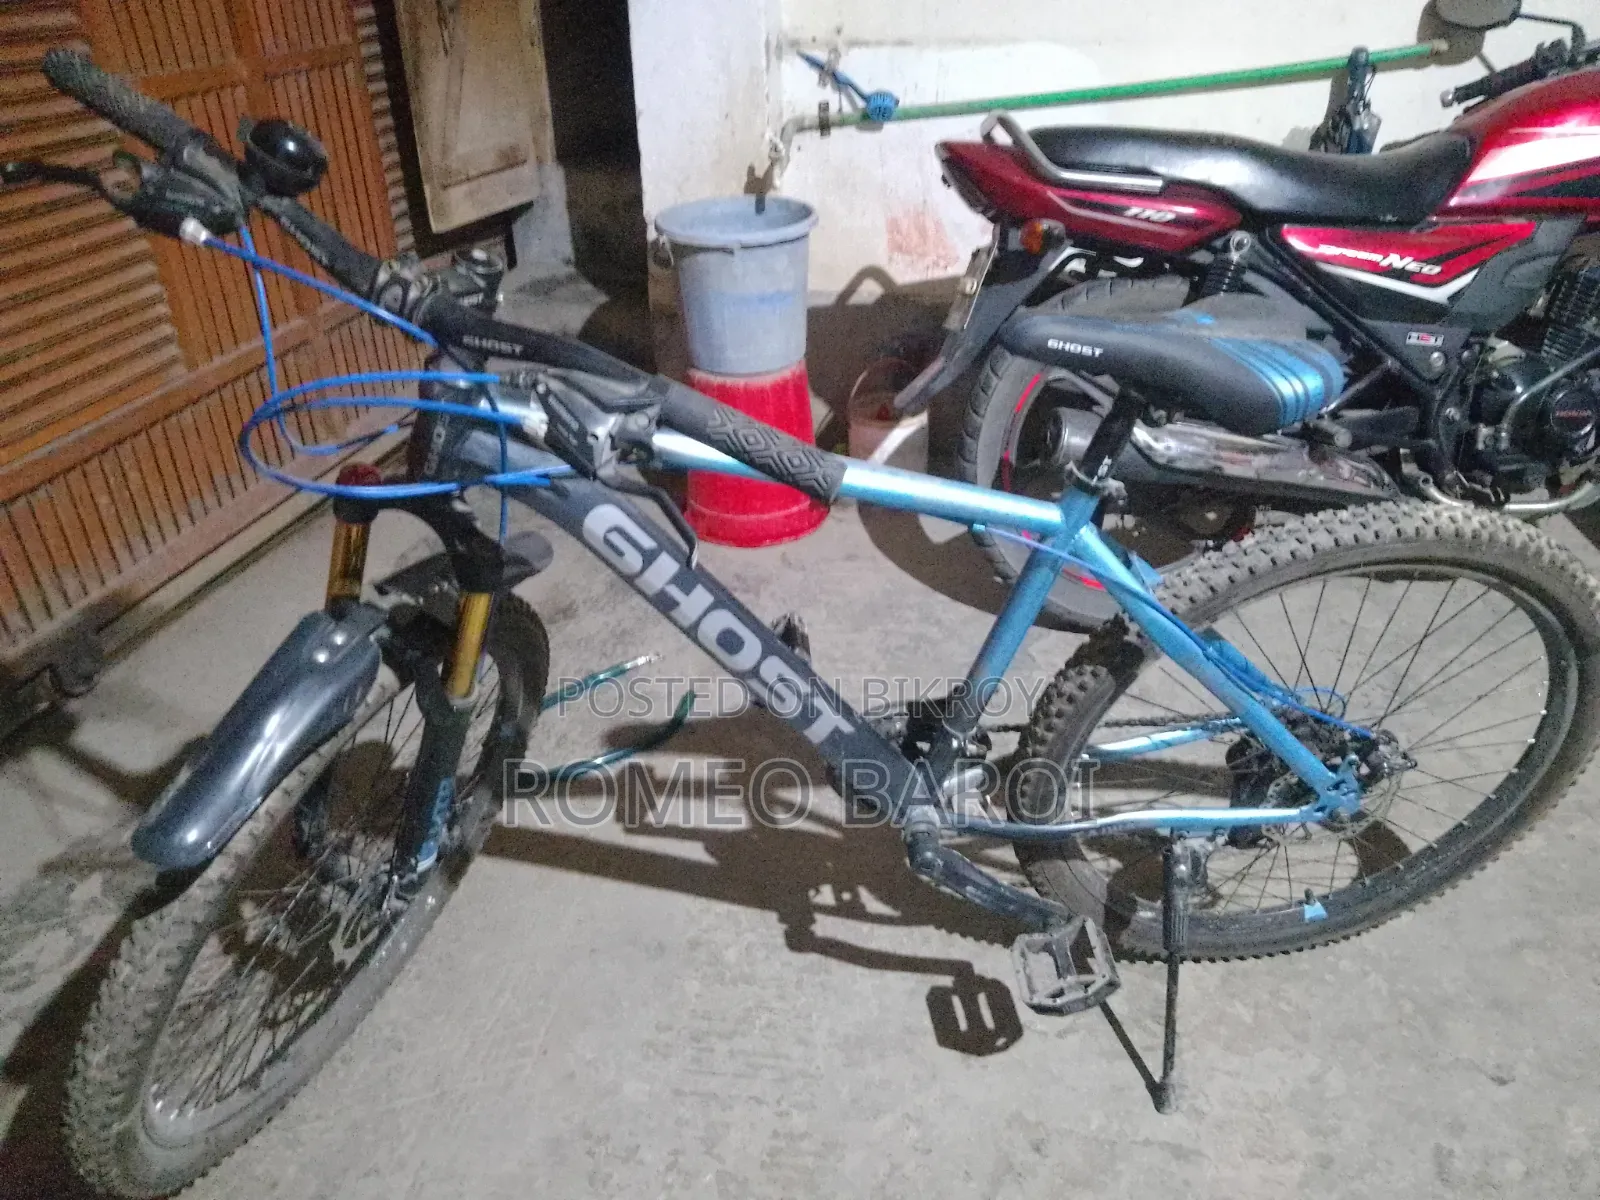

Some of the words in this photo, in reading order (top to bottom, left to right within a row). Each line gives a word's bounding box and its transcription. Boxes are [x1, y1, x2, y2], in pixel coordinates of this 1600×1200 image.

[1124, 206, 1177, 223] 110
[1047, 338, 1104, 358] GHOST
[582, 503, 855, 745] GHOST
